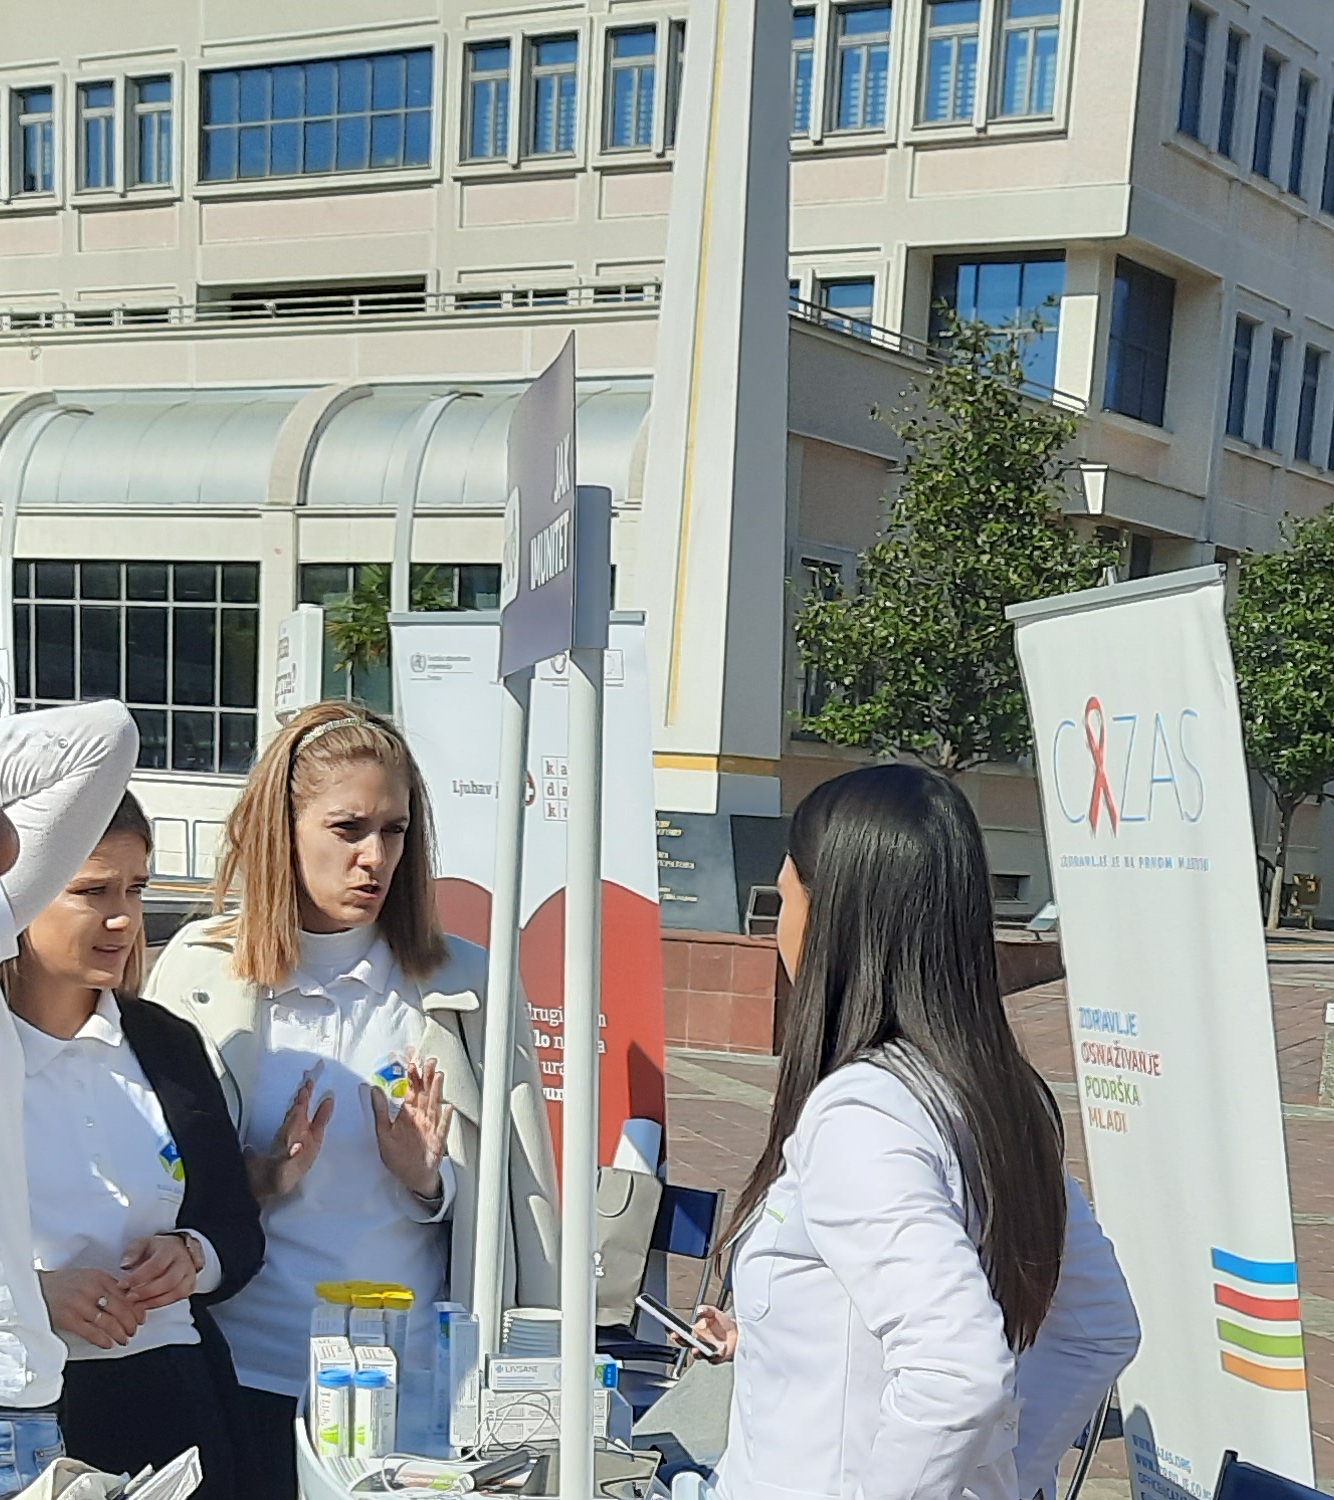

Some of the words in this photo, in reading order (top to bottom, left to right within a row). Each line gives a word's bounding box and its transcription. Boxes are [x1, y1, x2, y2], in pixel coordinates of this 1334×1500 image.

[530, 509, 570, 591] IMUNITET
[452, 780, 492, 796] Ljubav
[1078, 1006, 1138, 1036] ZDRAVLJE
[1081, 1040, 1162, 1076] OSNAŽIVANJE
[1084, 1074, 1142, 1107] PODRŠKA
[1087, 1106, 1128, 1134] MLADI
